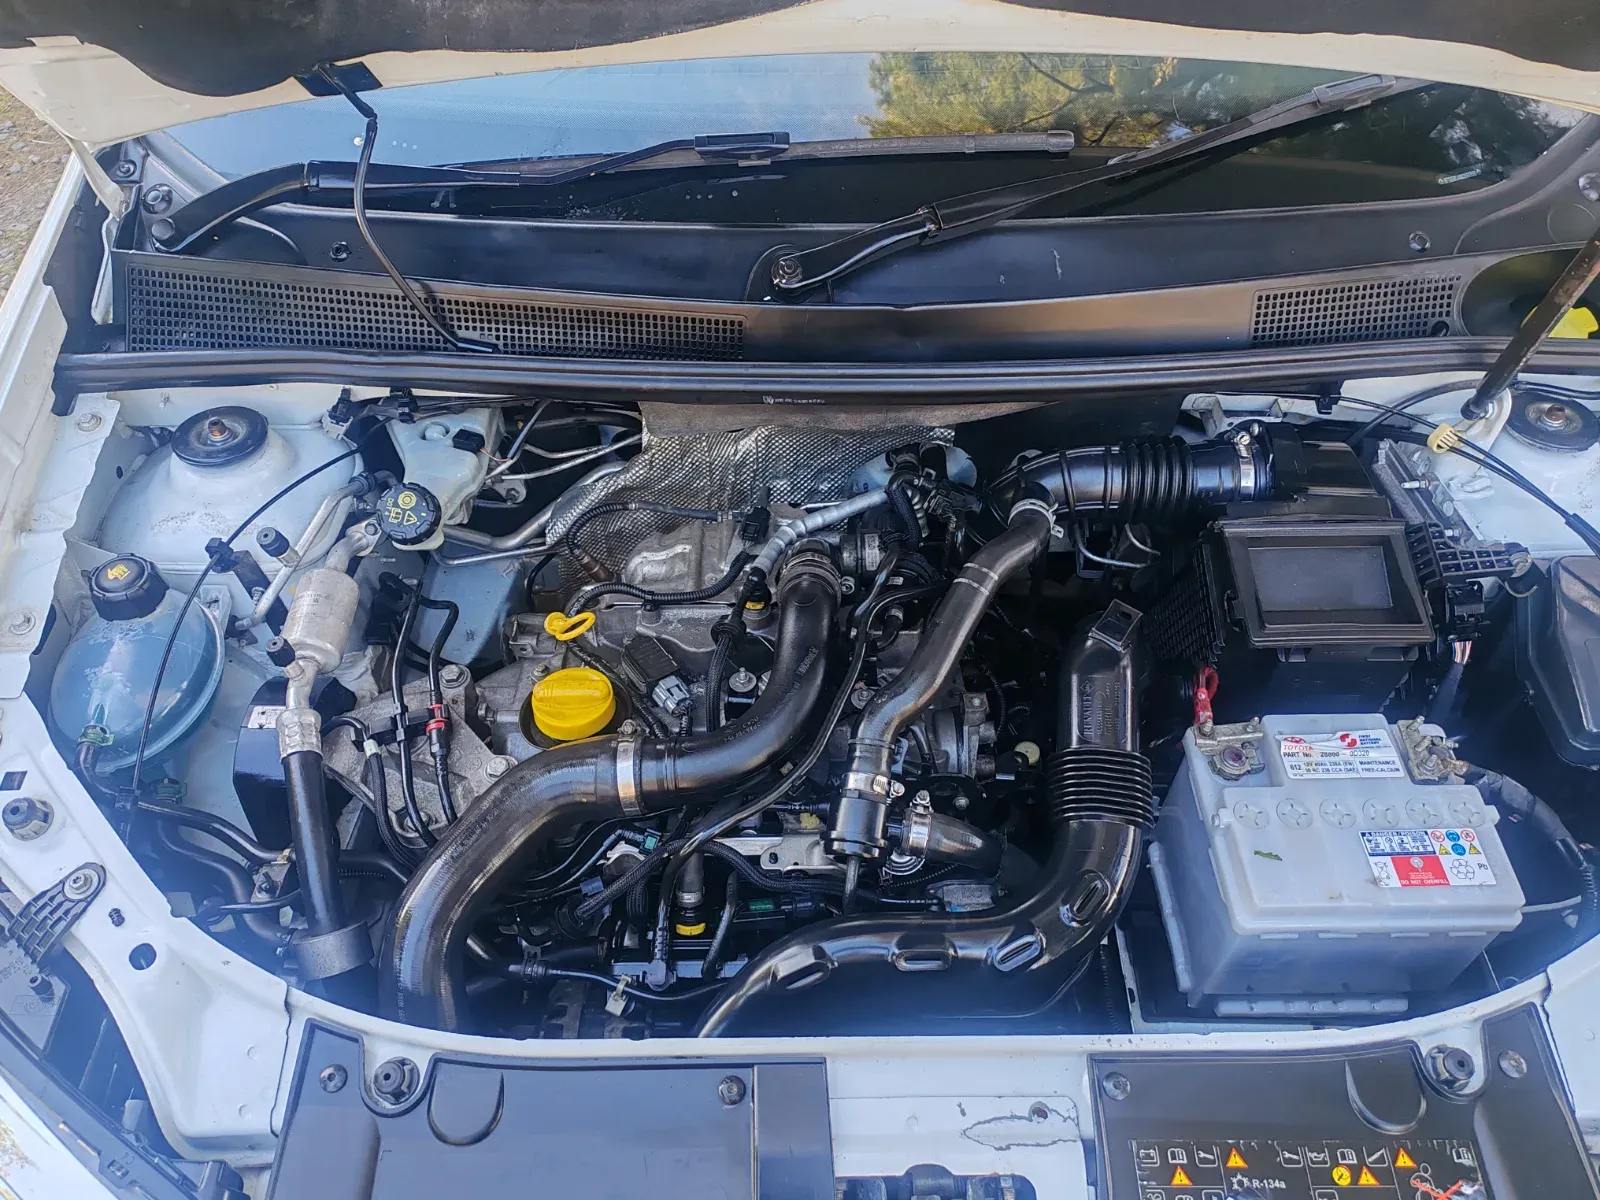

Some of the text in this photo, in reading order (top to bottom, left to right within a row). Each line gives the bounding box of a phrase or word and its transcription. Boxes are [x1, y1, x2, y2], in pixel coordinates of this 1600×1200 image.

[1083, 694, 1092, 735] RENAULT
[1477, 862, 1489, 870] Pb
[1252, 1178, 1287, 1189] R-134a
